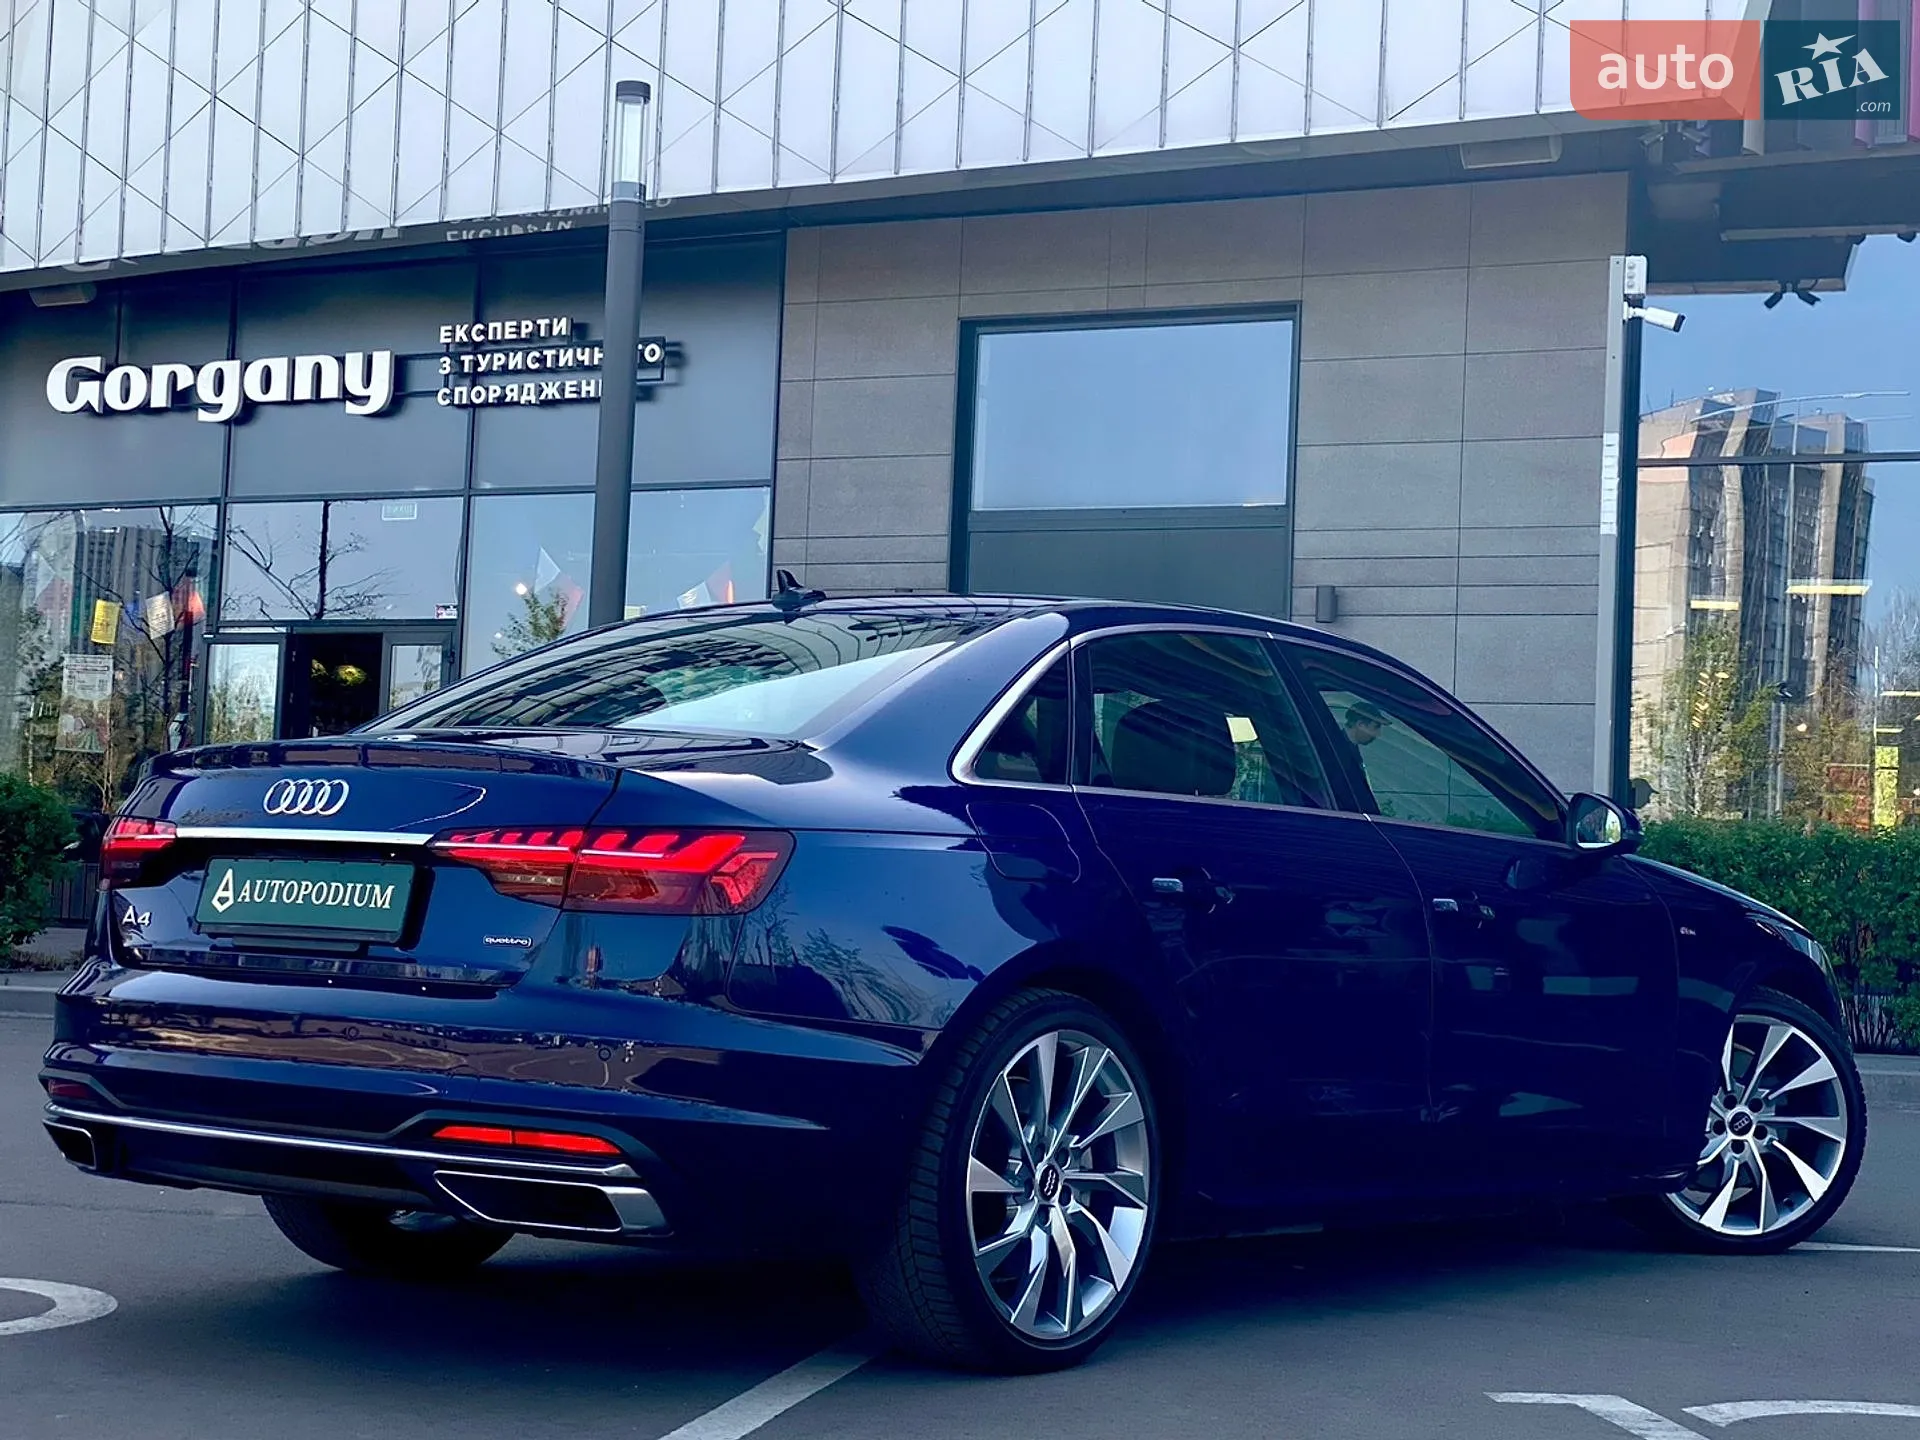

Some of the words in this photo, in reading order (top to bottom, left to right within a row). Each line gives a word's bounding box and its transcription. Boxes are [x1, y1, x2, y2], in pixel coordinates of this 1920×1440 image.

[439, 317, 569, 344] ЕКСПЕРТИ
[460, 343, 662, 374] ТУРИСТИЧНО
[46, 350, 392, 423] Gorgany
[437, 379, 603, 406] СПОРЯДЖЕН
[237, 879, 395, 910] AUTOPODIUM
[122, 905, 151, 926] A4
[485, 937, 528, 945] quattro
